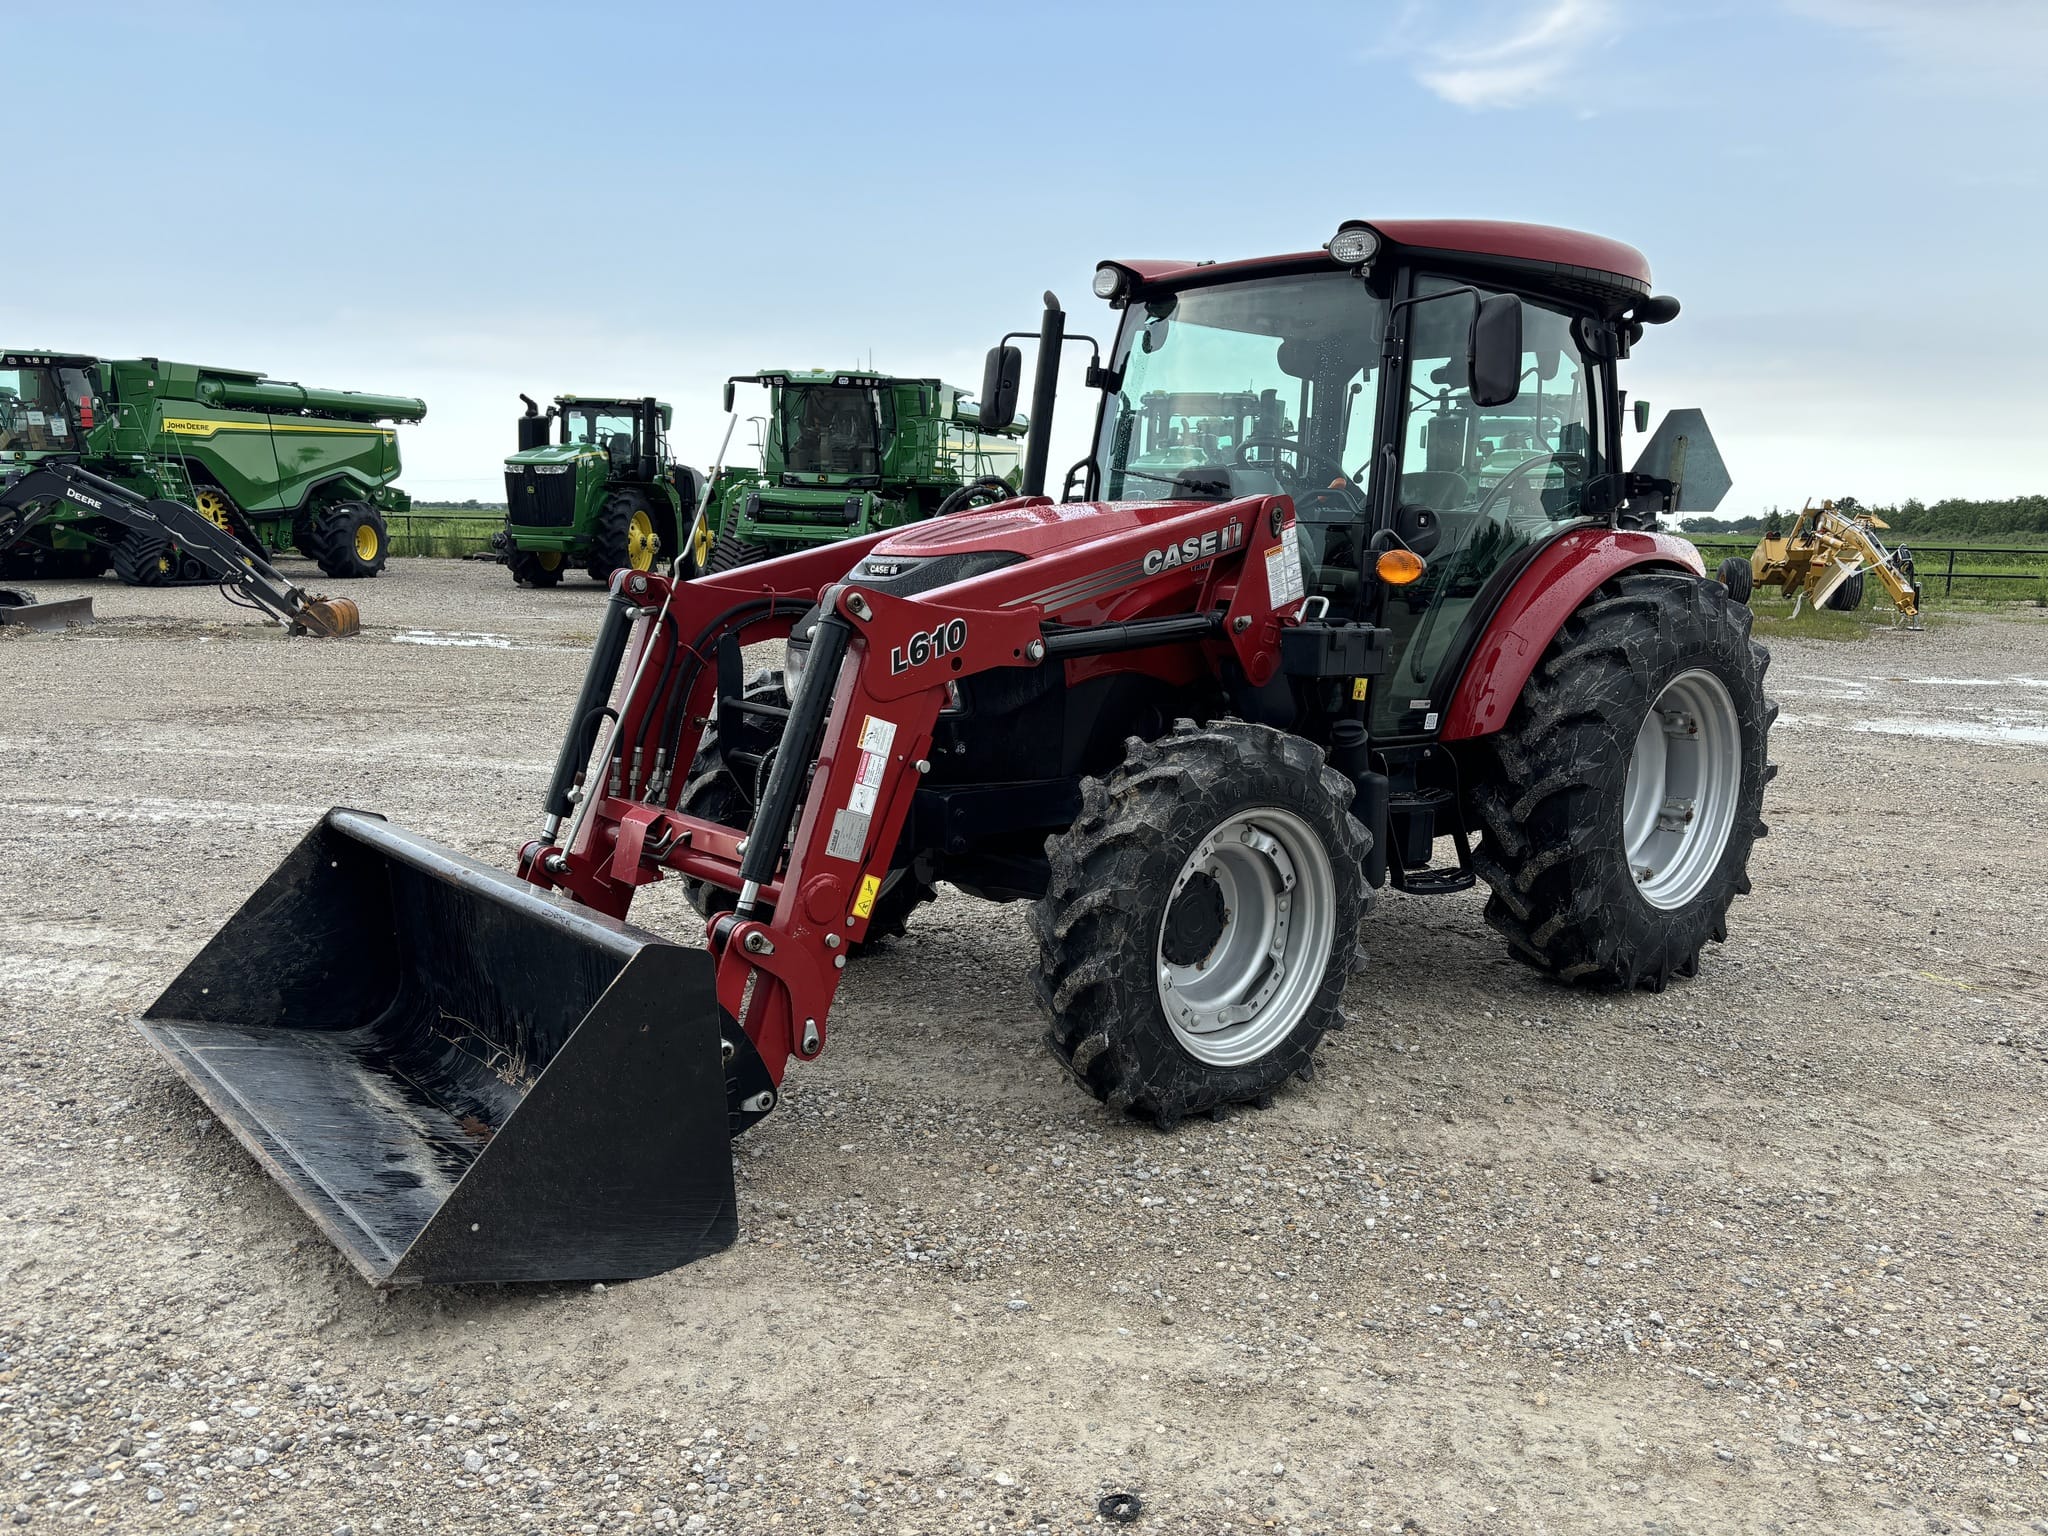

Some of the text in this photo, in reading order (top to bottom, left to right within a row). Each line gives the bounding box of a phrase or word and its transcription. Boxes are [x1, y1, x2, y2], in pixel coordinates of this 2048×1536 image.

[167, 421, 210, 431] JOHN DEERE
[66, 487, 103, 509] DEERE
[1143, 530, 1217, 576] CASE
[870, 564, 889, 574] CASE
[890, 617, 968, 676] L610
